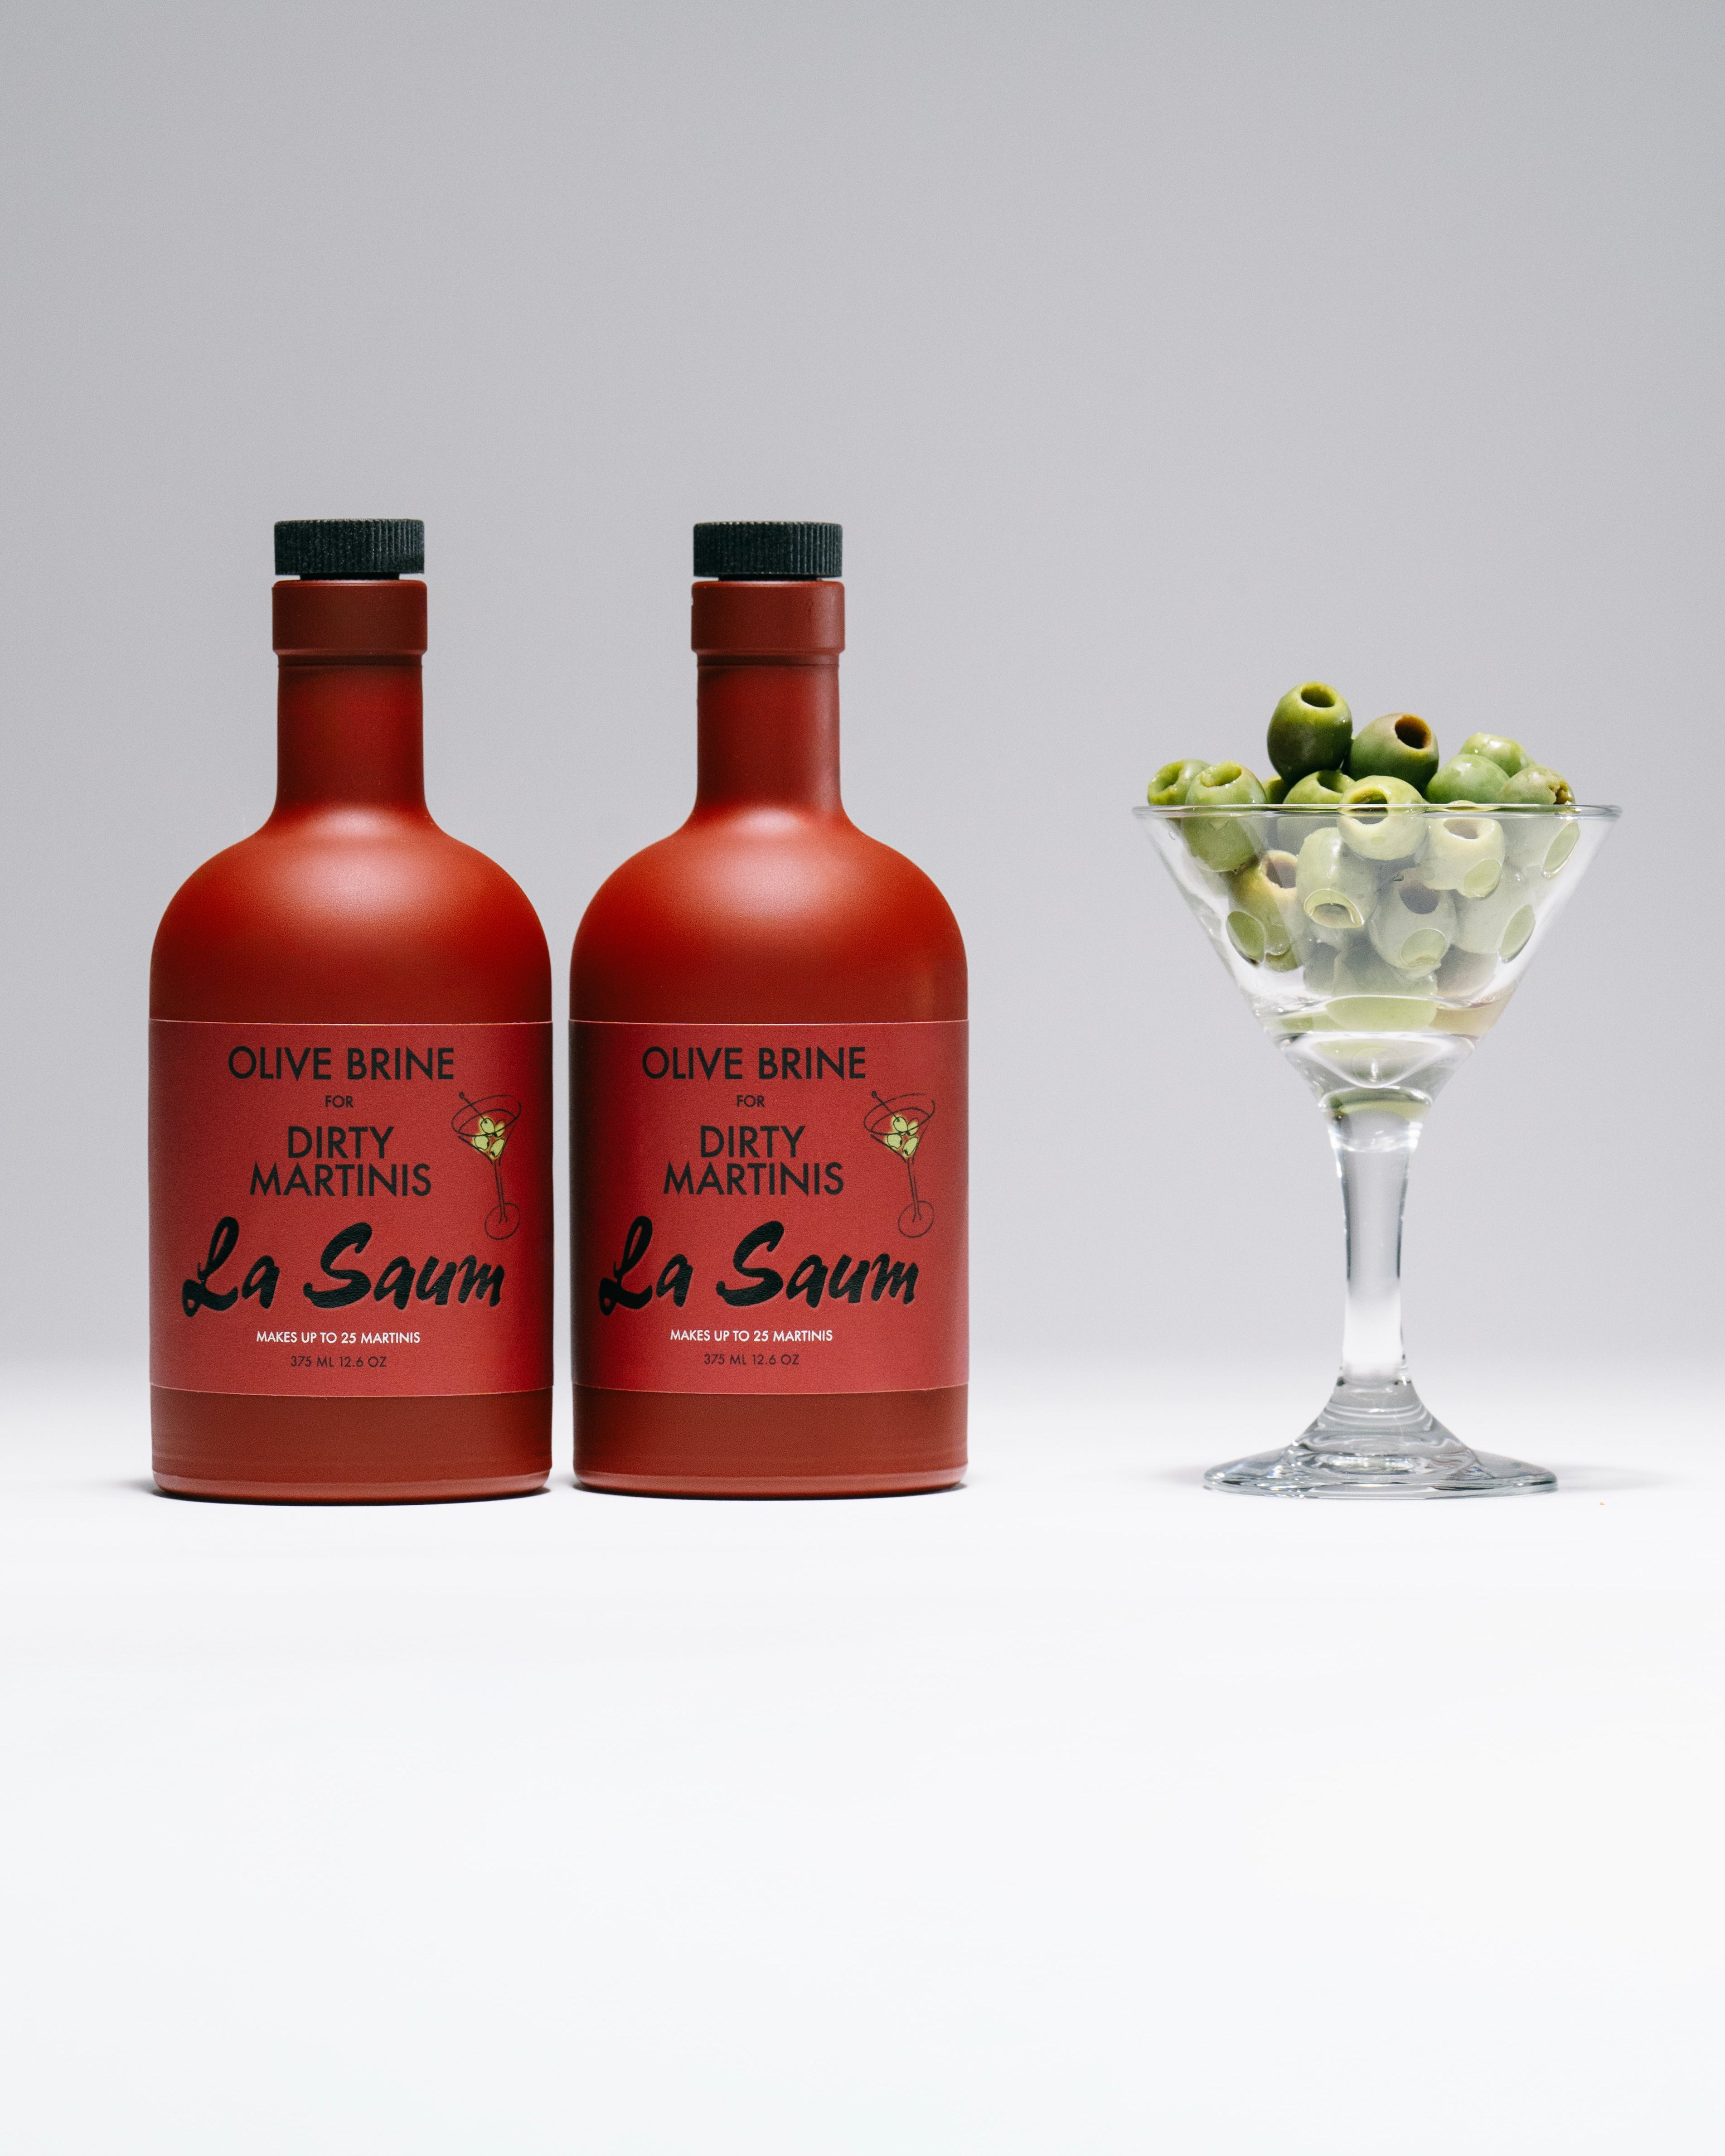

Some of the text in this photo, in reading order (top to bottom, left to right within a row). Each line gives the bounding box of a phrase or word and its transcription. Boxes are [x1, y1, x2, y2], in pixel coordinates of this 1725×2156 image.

[228, 1046, 454, 1080] OLIVE BRINE
[642, 1046, 866, 1080] OLIVE BRINE
[325, 1095, 354, 1108] FOR
[737, 1094, 765, 1107] FOR
[287, 1126, 394, 1158] DIRTY
[700, 1125, 806, 1158] DIRTY
[249, 1163, 431, 1197] MARTINIS
[663, 1162, 844, 1195] MARTINIS
[182, 1216, 505, 1317] La Saum
[599, 1215, 919, 1316] La Saum
[256, 1331, 421, 1344] MAKES UP TO 25 MARTINIS
[670, 1329, 833, 1341] MAKES UP TO 25 MARTINIS
[291, 1356, 387, 1368] 375 ML 12.6 OZ
[703, 1354, 800, 1365] 375 ML 12.6 OZ
